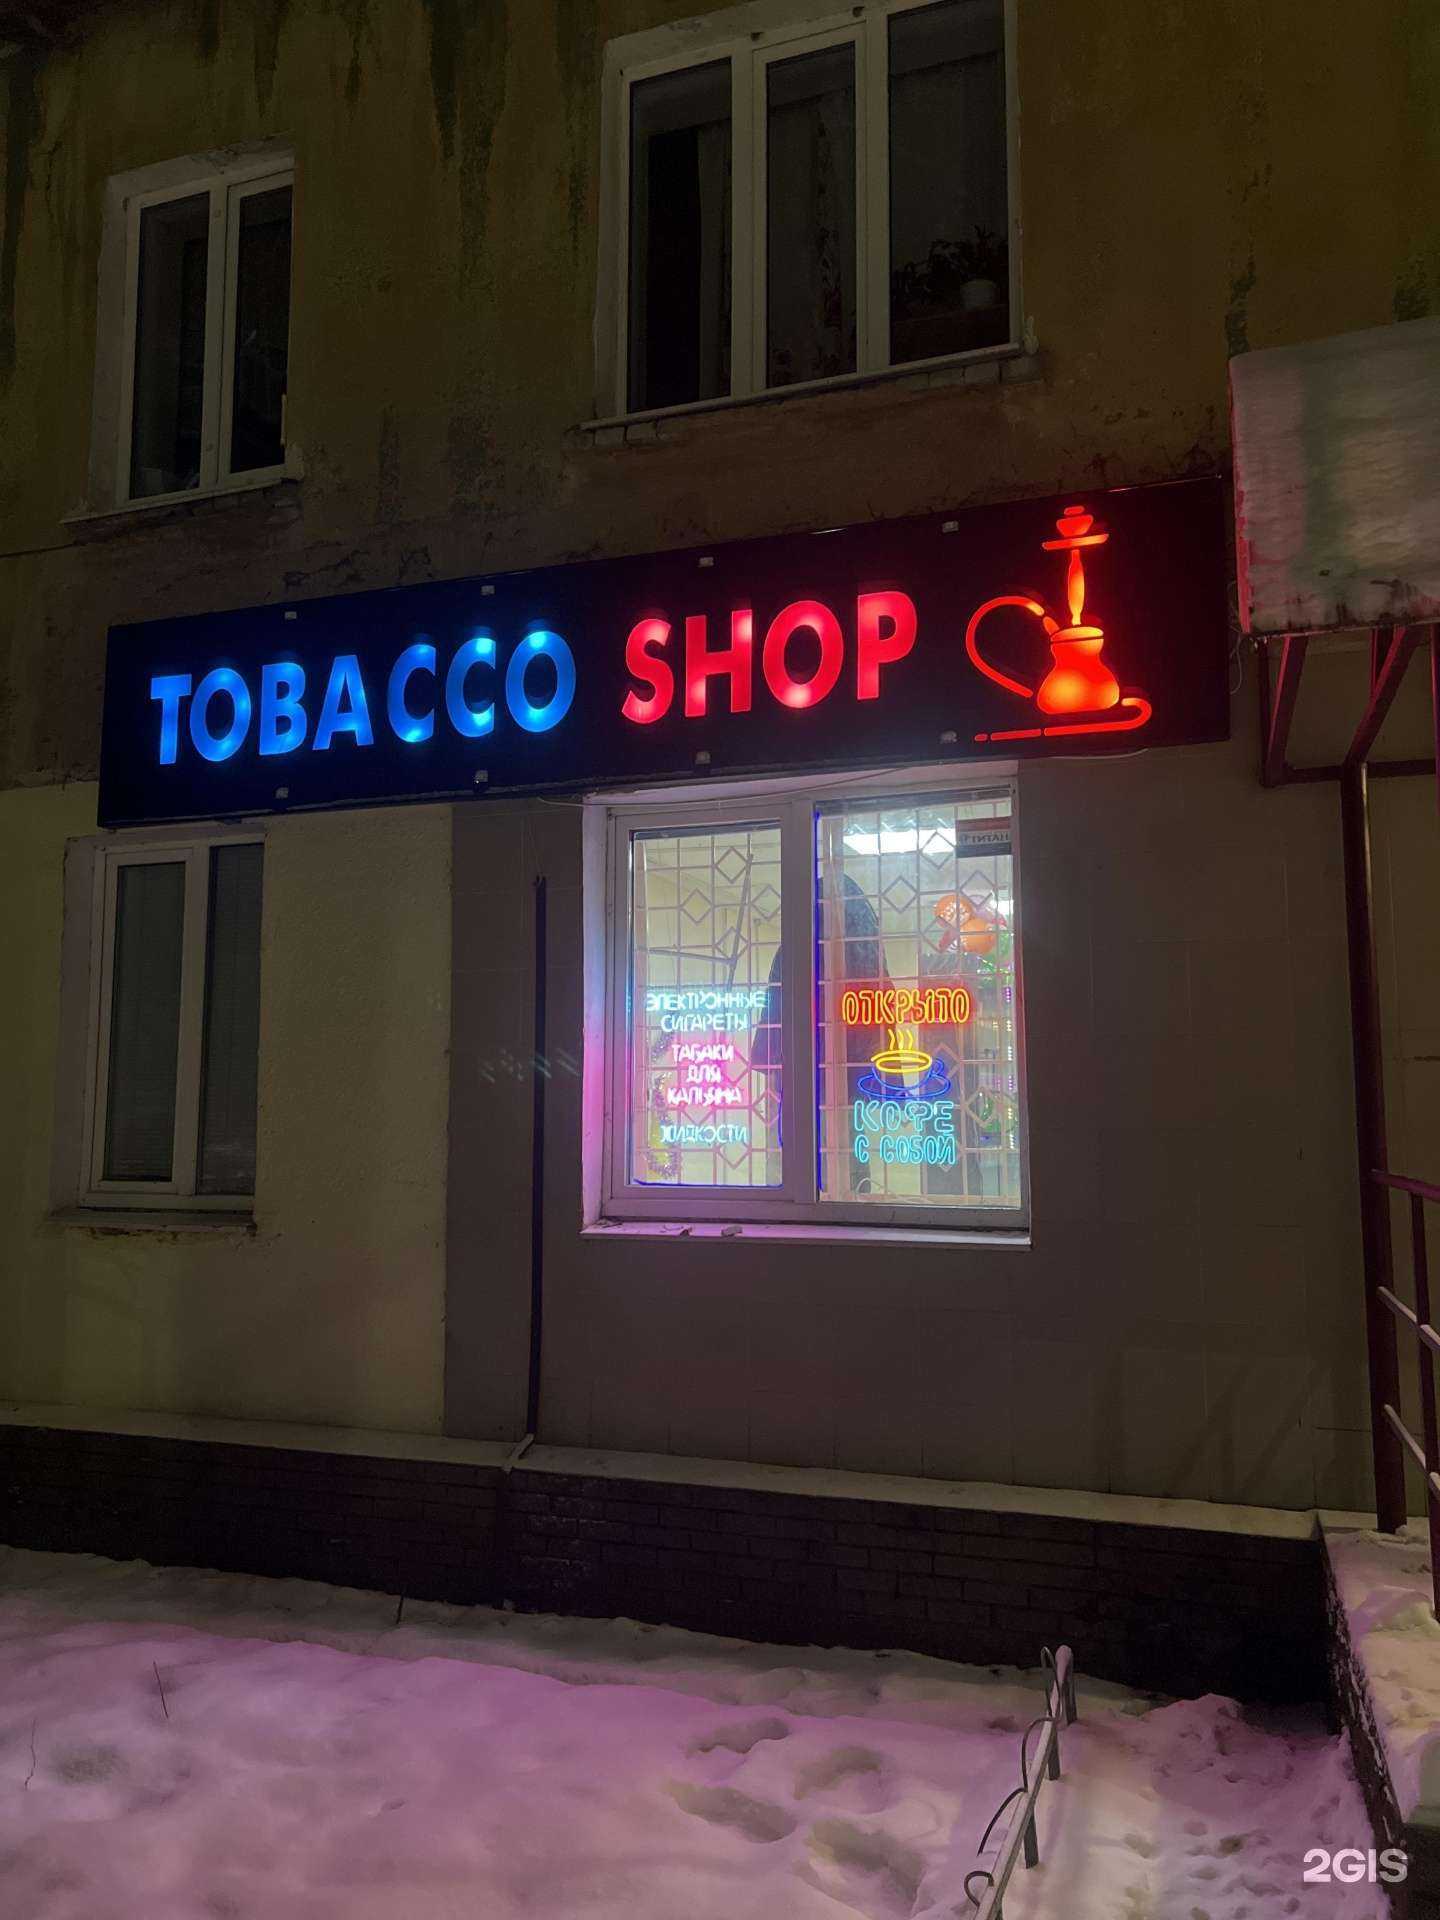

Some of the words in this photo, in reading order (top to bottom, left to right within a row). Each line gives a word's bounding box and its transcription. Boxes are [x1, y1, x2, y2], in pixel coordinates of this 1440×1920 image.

[150, 630, 576, 764] TOBACCO
[621, 590, 918, 724] SHOP
[646, 990, 768, 1011] ЭЛЕКТРОННЫЕ
[842, 988, 970, 1025] ОТКРЫТО
[660, 1013, 749, 1033] СИГАРЕТЫ
[671, 1043, 735, 1064] ТАБАКИ
[685, 1064, 722, 1083] ДЛЯ
[666, 1086, 743, 1106] КАЛЬЯНА
[854, 1100, 955, 1133] КОФЕ
[660, 1124, 749, 1144] ЖИДКОСТИ
[854, 1135, 870, 1163] С
[880, 1132, 956, 1164] СОБОЙ
